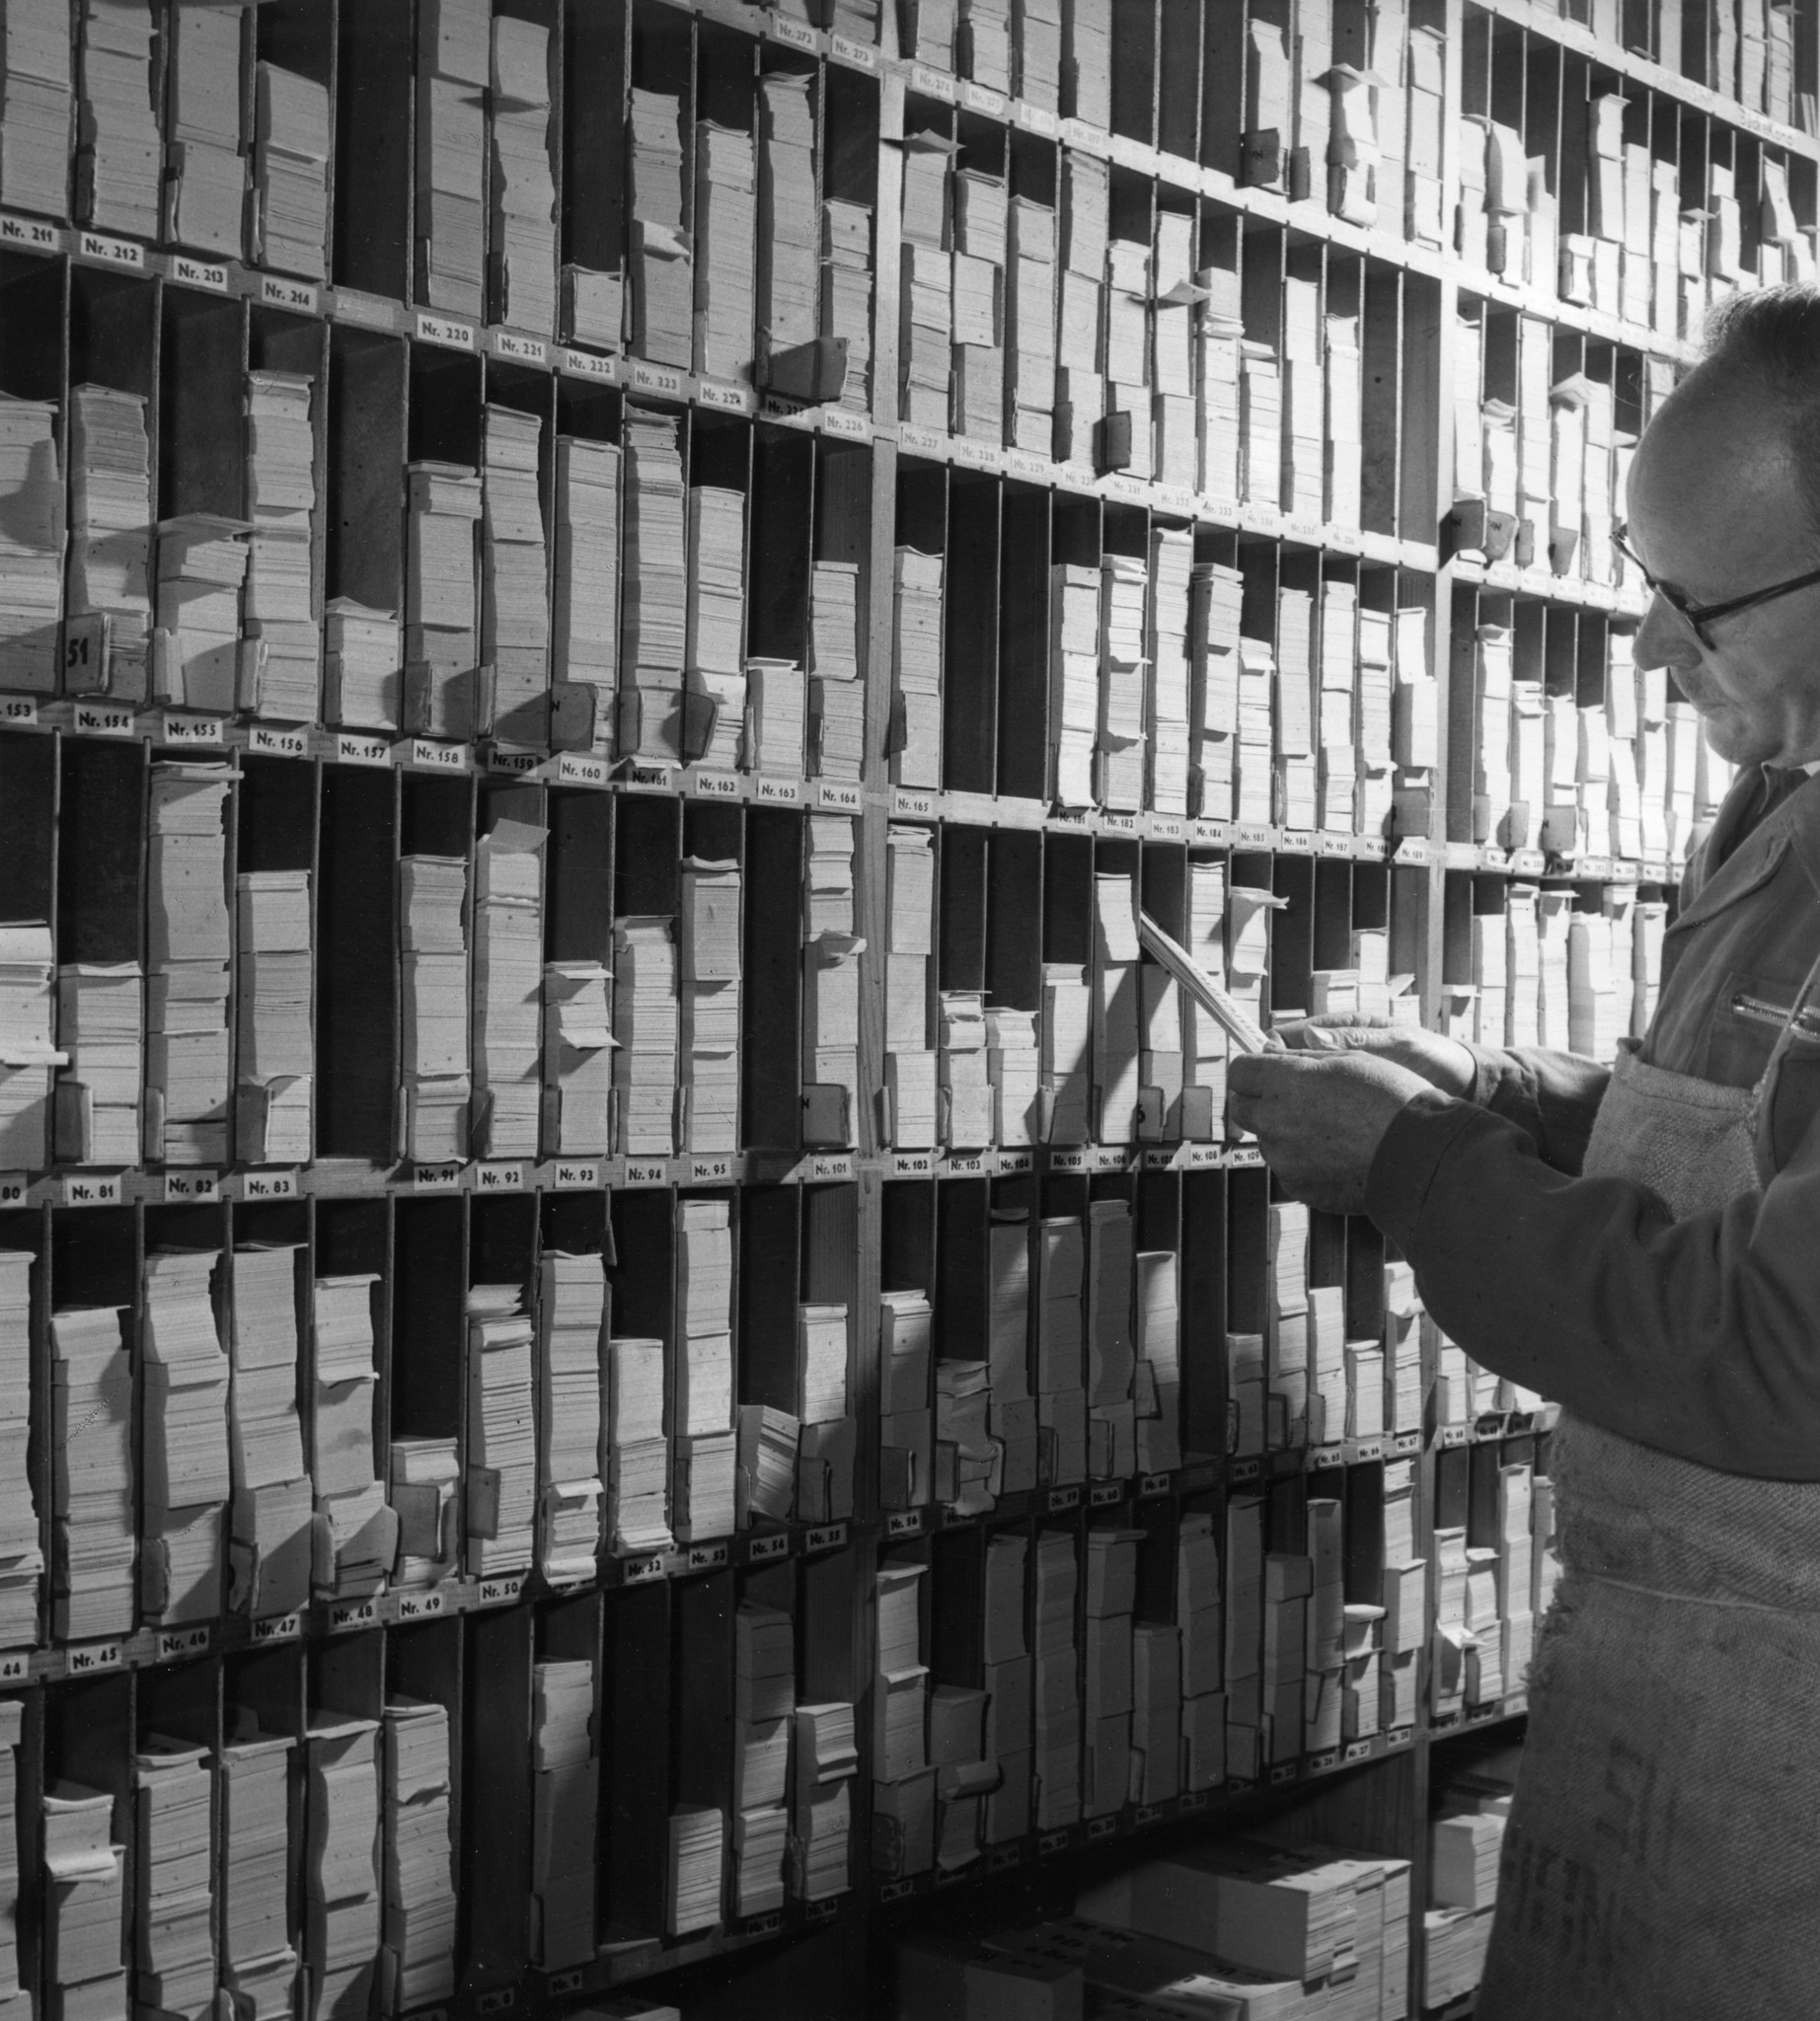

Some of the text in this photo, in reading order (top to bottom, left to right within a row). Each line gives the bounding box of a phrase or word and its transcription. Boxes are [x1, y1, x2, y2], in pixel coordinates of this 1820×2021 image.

[780, 23, 794, 37] Nr.
[835, 40, 850, 55] Nr.
[2, 220, 53, 243] Nr. 211
[86, 239, 138, 262] Nr. 212
[178, 262, 224, 283] Nr. 213
[265, 282, 310, 306] Nr. 214
[422, 322, 469, 341] Nr. 220
[501, 339, 541, 357] Nr. 221
[569, 355, 610, 374] Nr. 222
[636, 371, 677, 391] Nr. 223
[703, 388, 718, 403] Nr.
[768, 401, 803, 417] Nr. 225
[827, 416, 863, 432] Nr. 226
[904, 432, 938, 449] Nr. 227
[961, 446, 975, 458] Nr.
[1015, 458, 1026, 470] Nr.
[6, 704, 32, 716] 153
[79, 712, 128, 728] Nr. 154
[168, 722, 216, 737] Nr. 155
[257, 732, 303, 752] Nr. 156
[341, 742, 386, 759] Nr. 157
[417, 746, 458, 764] Nr. 158
[493, 752, 533, 771] Nr. 159
[563, 763, 600, 780] Nr. 160
[632, 771, 667, 786] Nr. 161
[699, 778, 734, 791] Nr. 162
[762, 786, 796, 798] Nr. 163
[823, 789, 857, 804] Nr. 164
[898, 797, 929, 812] Nr. 165
[1059, 811, 1086, 825] Nr. 181
[1107, 815, 1133, 829] Nr. 182
[1153, 824, 1178, 835] Nr. 183
[1196, 826, 1222, 839] Nr. 184
[1241, 832, 1265, 843] Nr. 185
[1283, 837, 1307, 847] Nr. 186
[1325, 841, 1347, 853] Nr. 187
[1366, 842, 1376, 852] Nr.
[1402, 849, 1411, 858] Nr.
[1054, 1155, 1082, 1166] Nr. 105
[1100, 1155, 1126, 1166] Nr. 106
[1148, 1155, 1173, 1164] Nr. 107
[1192, 1151, 1217, 1162] Nr. 108
[1234, 1151, 1259, 1162] Nr. 109
[695, 1162, 726, 1177] Nr. 95
[815, 1162, 847, 1174] Nr. 101
[897, 1160, 928, 1170] Nr. 102
[950, 1160, 981, 1171] Nr. 103
[1001, 1159, 1029, 1171] Nr. 104
[418, 1168, 454, 1182] Nr. 91
[482, 1170, 519, 1184] Nr. 92
[559, 1168, 592, 1181] Nr. 93
[628, 1168, 661, 1180] Nr. 94
[2, 1186, 20, 1200] 80
[73, 1185, 114, 1200] Nr. 81
[169, 1178, 212, 1194] Nr. 82
[249, 1180, 290, 1194] Nr. 83
[1145, 1480, 1157, 1491] Nr.
[1051, 1496, 1064, 1507] Nr.
[1093, 1490, 1117, 1503] Nr. 60
[891, 1516, 918, 1532] Nr. 56
[809, 1530, 841, 1545] Nr. 55
[752, 1539, 785, 1555] Nr. 54
[692, 1549, 726, 1565] Nr. 53
[628, 1560, 661, 1577] Nr. 52
[483, 1581, 519, 1599] Nr. 50
[401, 1598, 440, 1616] Nr. 49
[334, 1606, 373, 1624] Nr. 48
[255, 1618, 296, 1637] Nr. 47
[163, 1630, 206, 1653] Nr. 46
[73, 1648, 116, 1670] Nr. 45
[4, 1662, 21, 1676] 44
